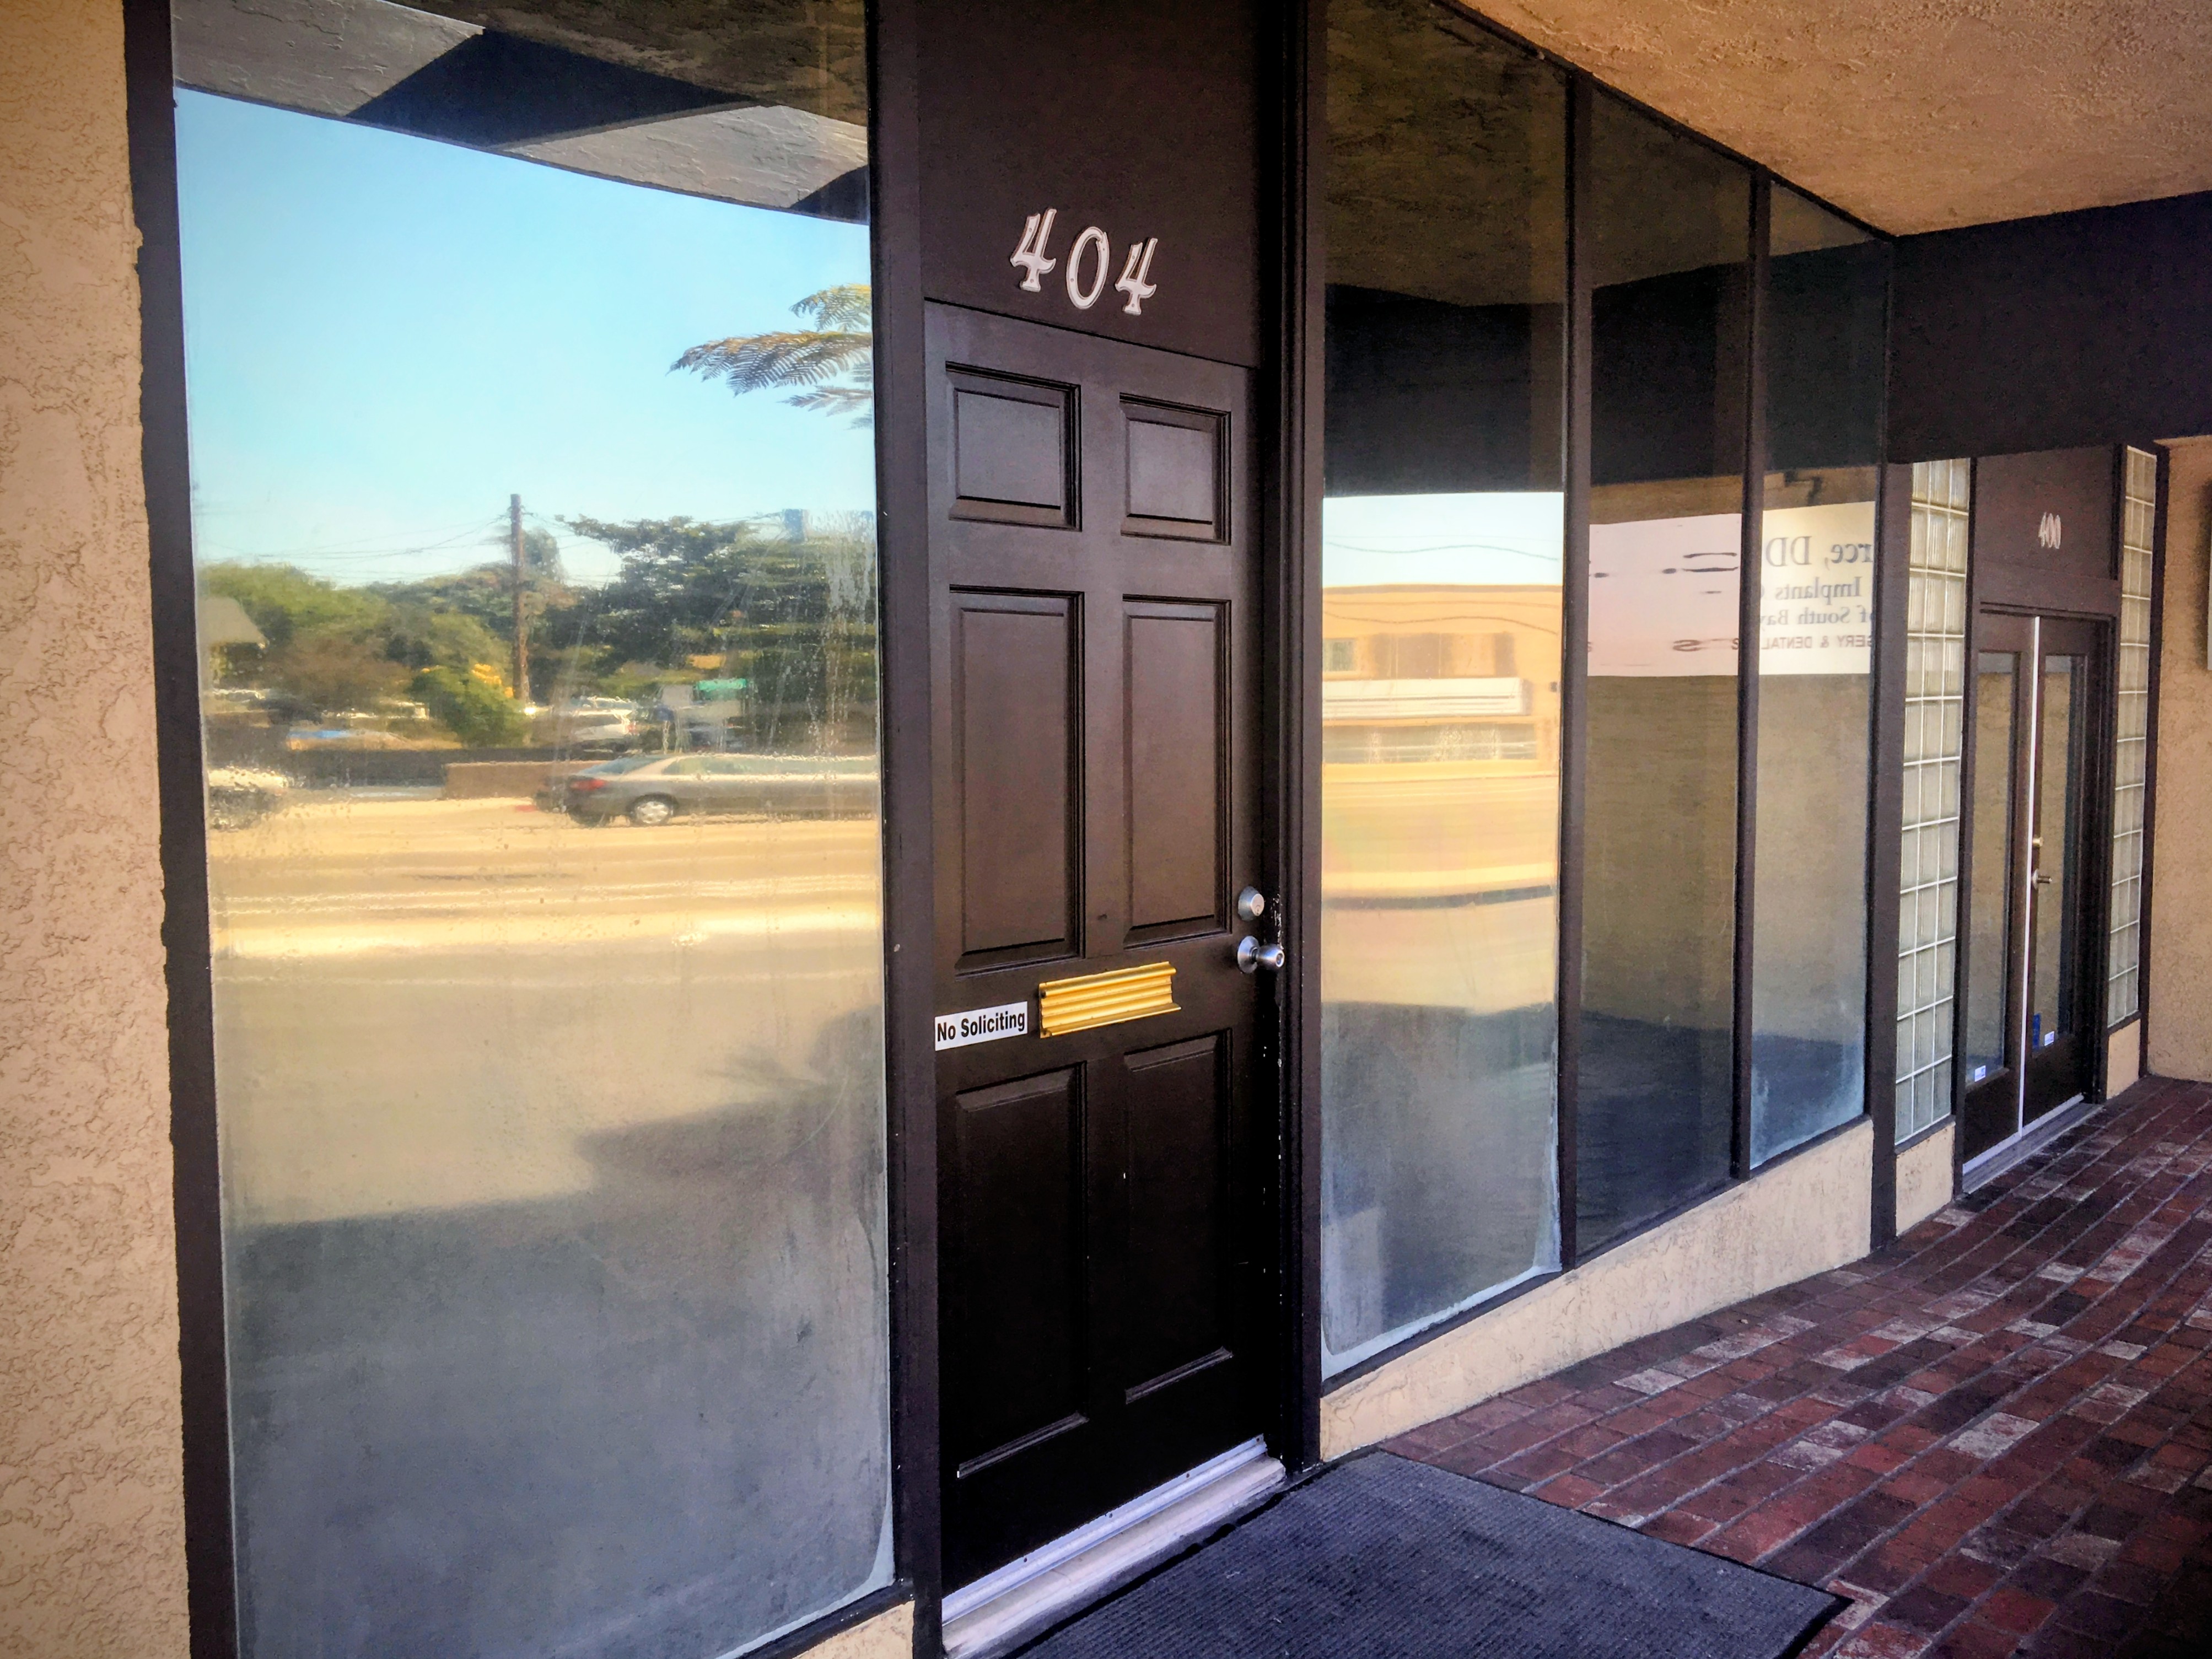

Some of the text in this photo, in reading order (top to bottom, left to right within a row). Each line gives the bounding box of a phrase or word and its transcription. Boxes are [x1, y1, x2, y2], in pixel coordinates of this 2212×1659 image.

[1010, 208, 1158, 316] 404
[937, 1011, 1025, 1042] No Soliciting
